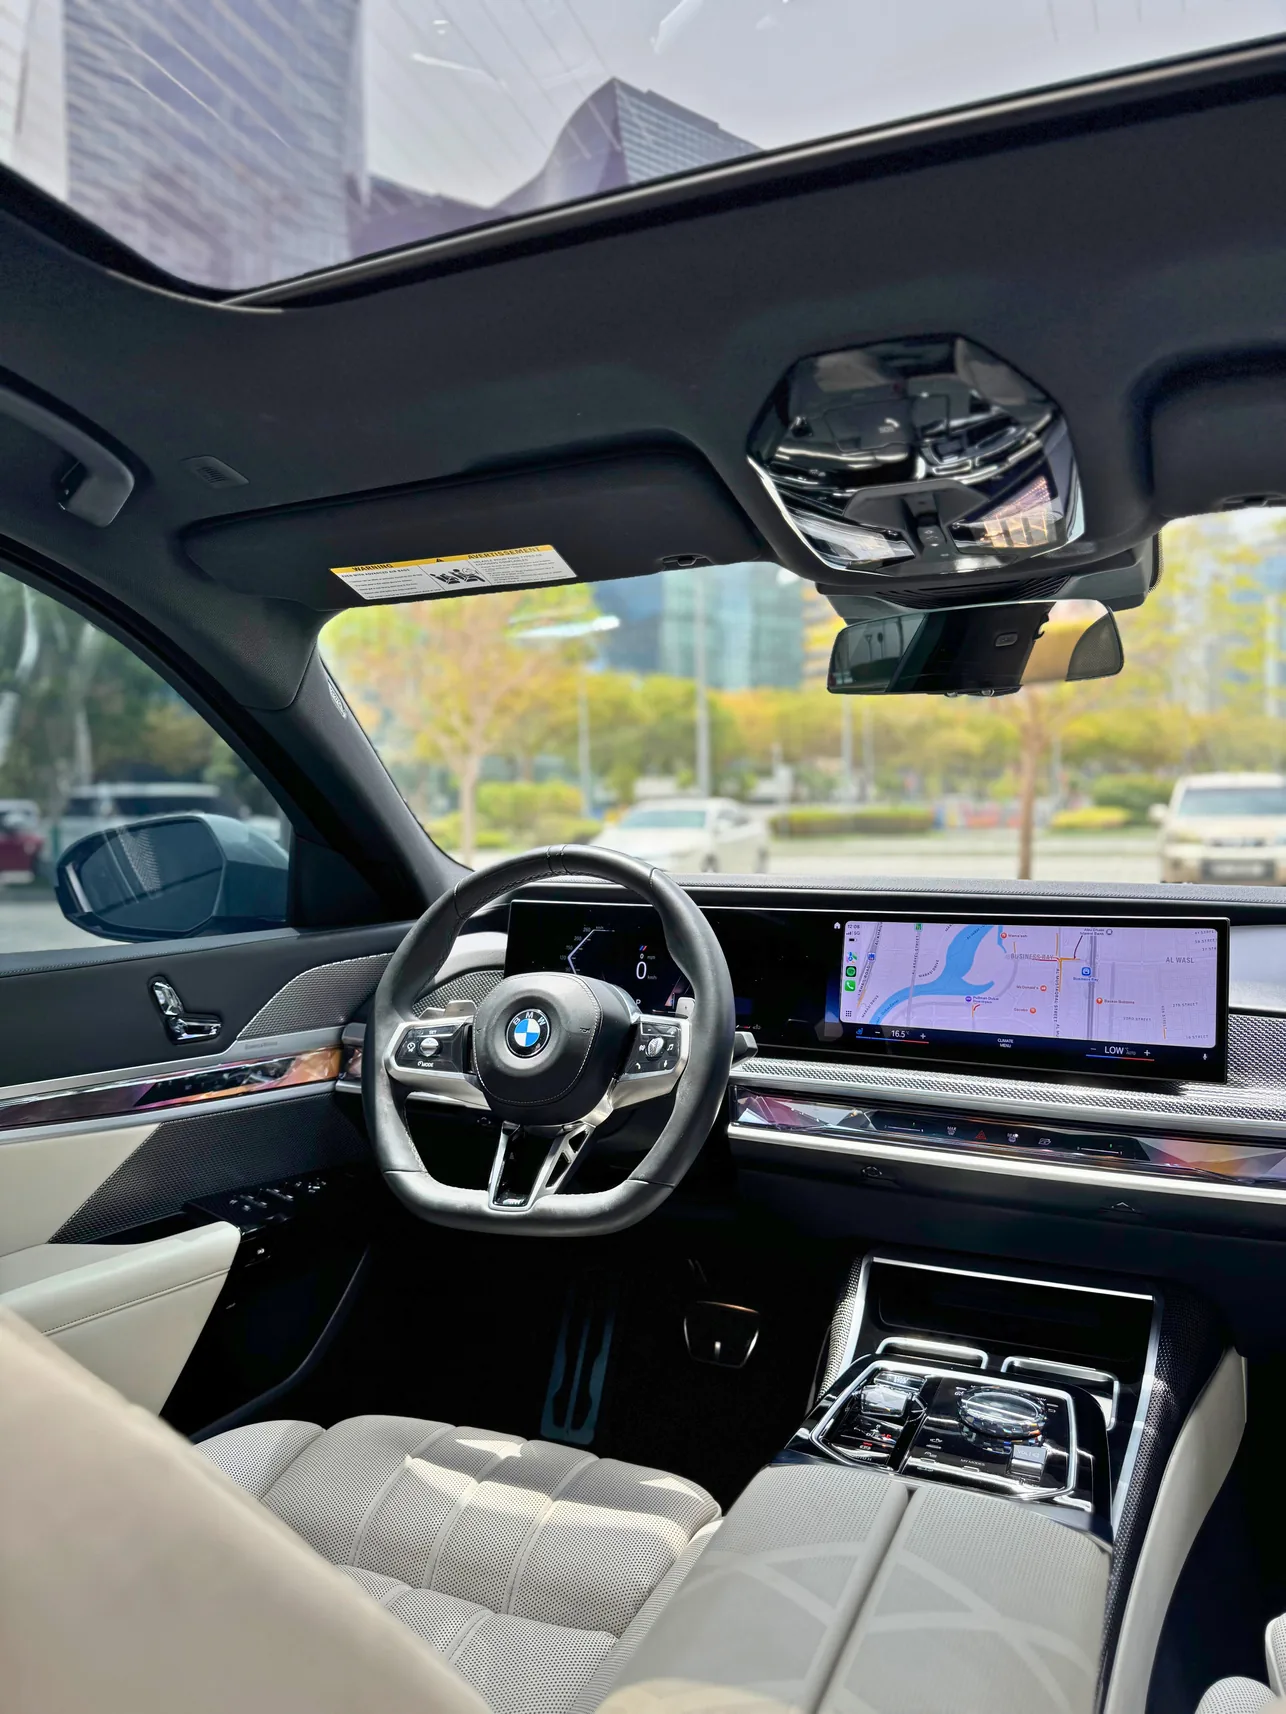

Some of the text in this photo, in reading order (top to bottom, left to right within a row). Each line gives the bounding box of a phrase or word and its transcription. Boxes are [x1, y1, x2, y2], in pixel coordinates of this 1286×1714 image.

[467, 546, 541, 560] AVERTISSEMENT
[352, 563, 394, 572] WARNING
[1010, 952, 1041, 960] BUSINESS
[1165, 956, 1195, 964] AL WASL
[635, 960, 648, 980] 0
[512, 1010, 547, 1027] BMW
[890, 1029, 906, 1038] 16.5
[1104, 1045, 1124, 1055] LOW
